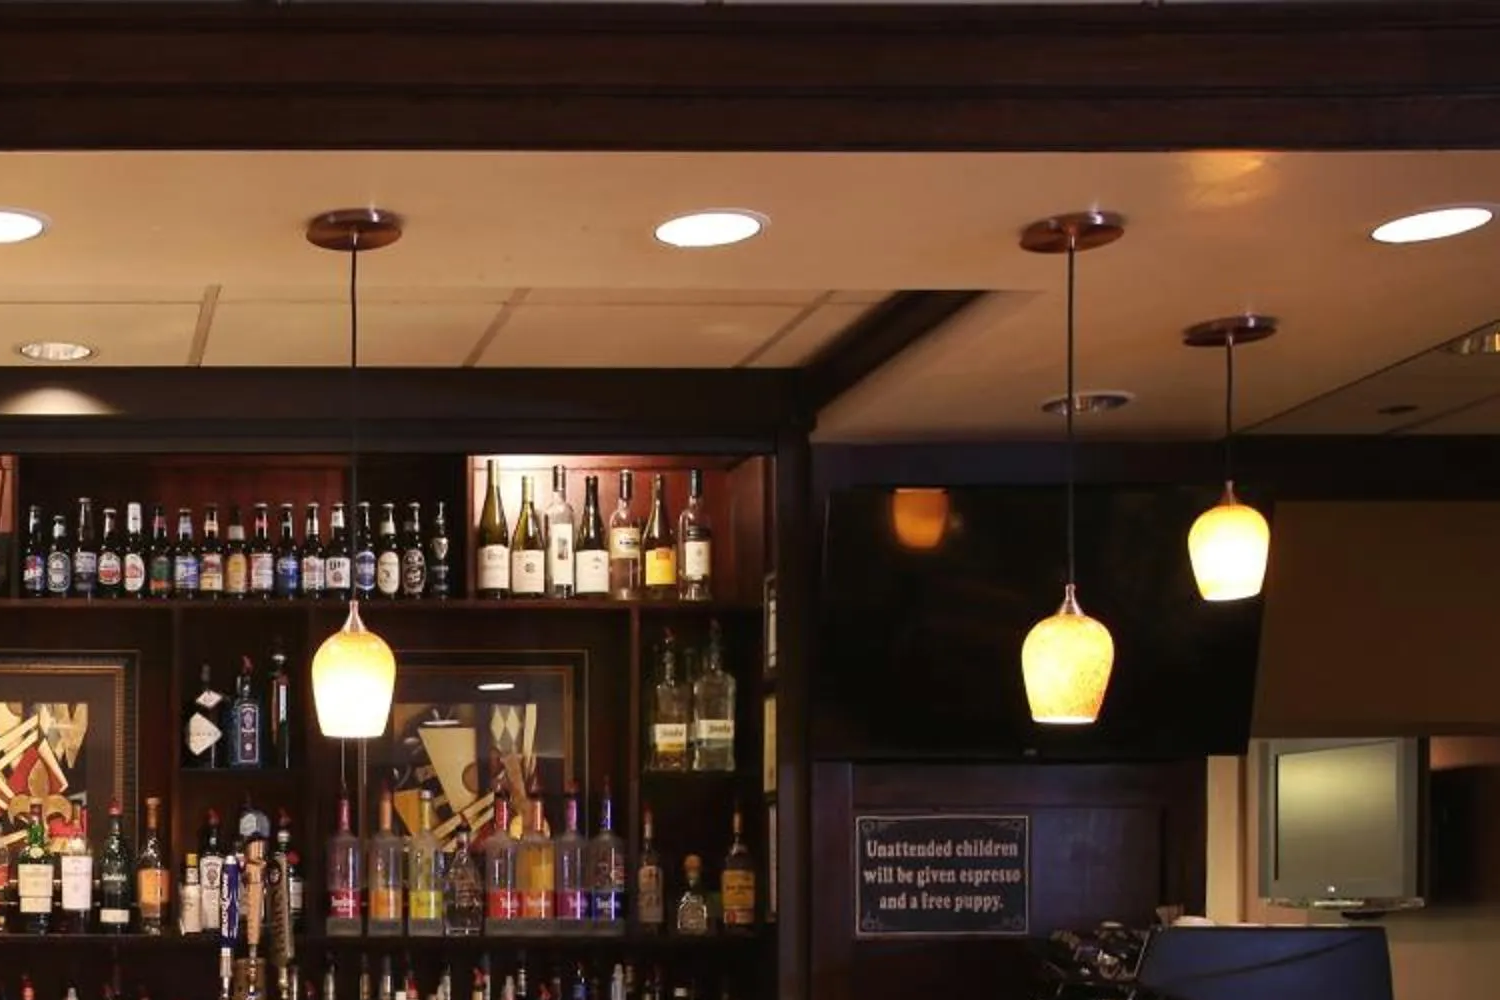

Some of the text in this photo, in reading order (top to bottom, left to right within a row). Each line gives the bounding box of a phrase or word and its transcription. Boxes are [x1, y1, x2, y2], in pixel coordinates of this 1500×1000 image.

[866, 840, 1018, 857] Unattended children
[863, 866, 1021, 888] will be given espresso
[879, 892, 1004, 912] and a free puppy.
